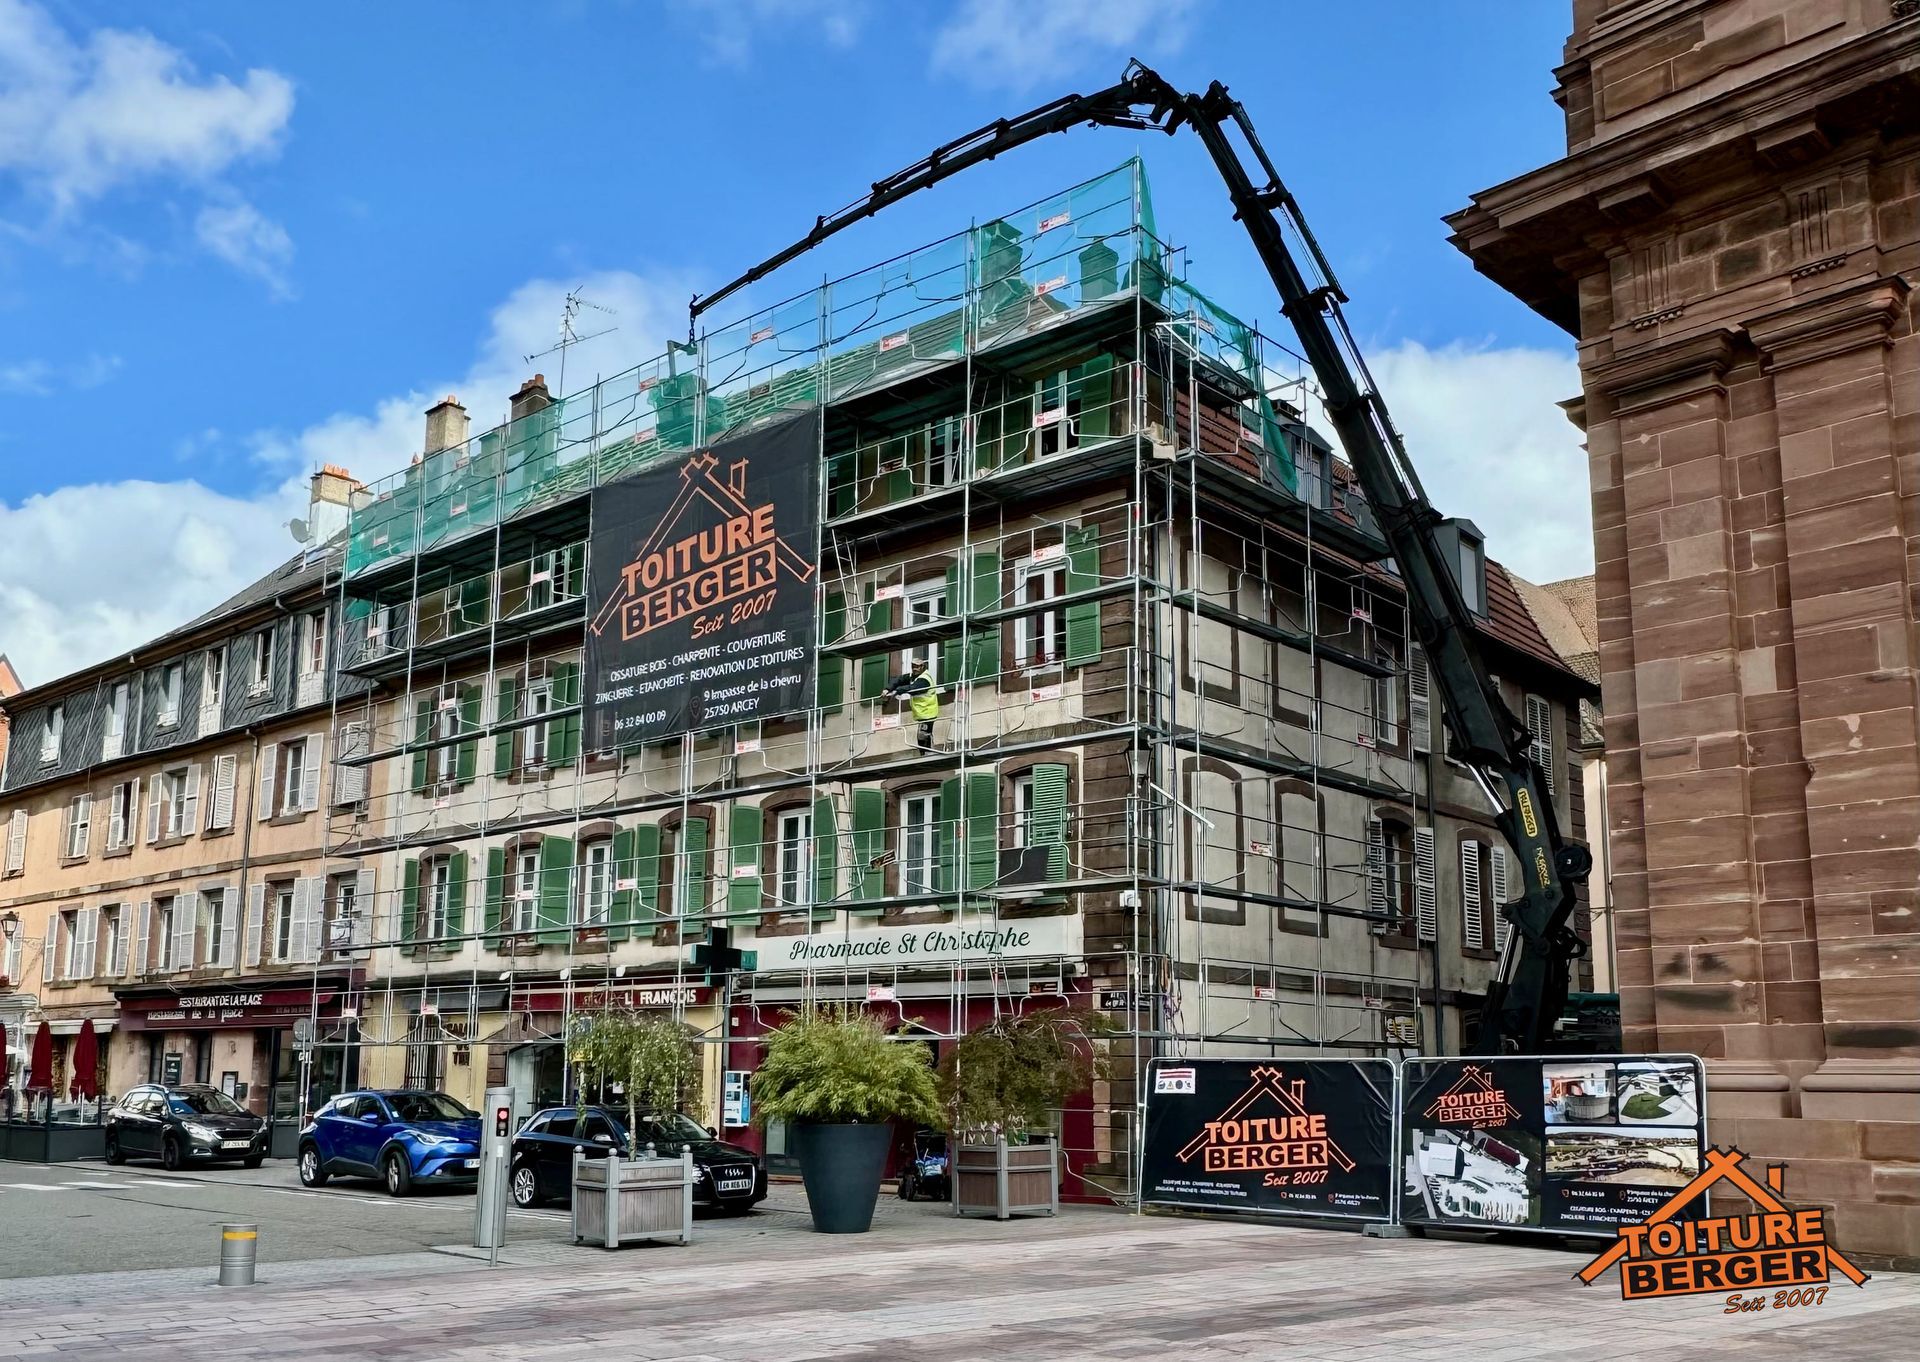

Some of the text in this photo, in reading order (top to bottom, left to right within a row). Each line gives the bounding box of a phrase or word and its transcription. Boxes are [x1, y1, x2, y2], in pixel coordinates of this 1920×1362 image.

[621, 502, 775, 597] TOITURE
[625, 547, 774, 638] BERGER
[691, 588, 777, 640] Seit 2007
[610, 630, 787, 682] OSSATURE BOIS CHARPENTE COUVERTURE
[690, 659, 745, 681] RENOVATION
[746, 656, 760, 670] DE
[760, 646, 805, 667] TOITURES
[703, 674, 801, 702] 9 Impasse de la chevru
[625, 716, 635, 728] 32
[645, 711, 656, 724] 00
[656, 709, 667, 721] 09
[703, 696, 761, 720] 25750 ARCEY
[789, 936, 892, 961] Pharmacie
[897, 932, 917, 956] St
[1437, 1089, 1505, 1109] TOITURE
[1440, 1104, 1506, 1122] BERGER
[1204, 1114, 1327, 1144] TOITURE
[1207, 1142, 1326, 1170] BERGER
[1292, 1169, 1329, 1185] 2007
